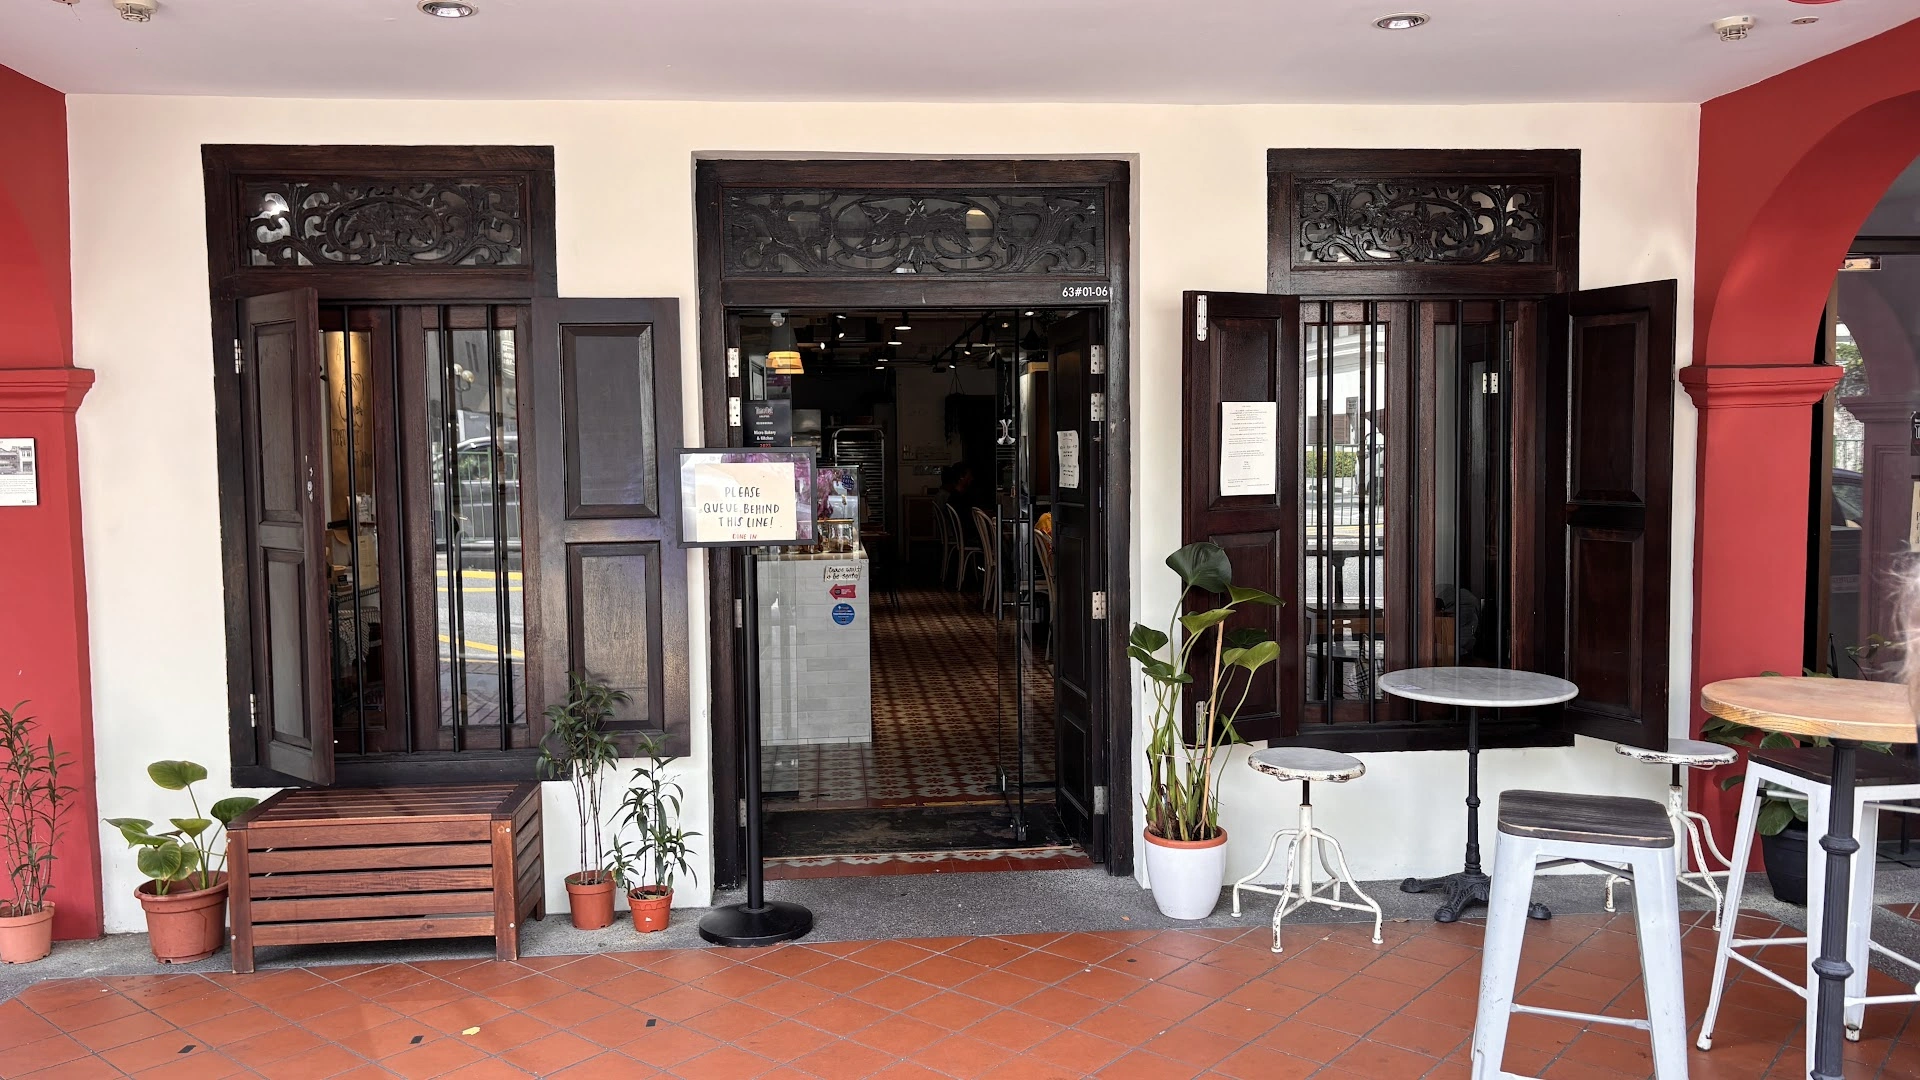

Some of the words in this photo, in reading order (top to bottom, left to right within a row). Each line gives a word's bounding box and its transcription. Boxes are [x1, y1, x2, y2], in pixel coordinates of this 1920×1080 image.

[1062, 286, 1108, 297] 63#01-06
[725, 486, 761, 498] PLEASE
[703, 503, 739, 513] QUEUE
[743, 503, 780, 514] BEHIND
[718, 517, 743, 527] THIS
[747, 517, 774, 528] LINE!
